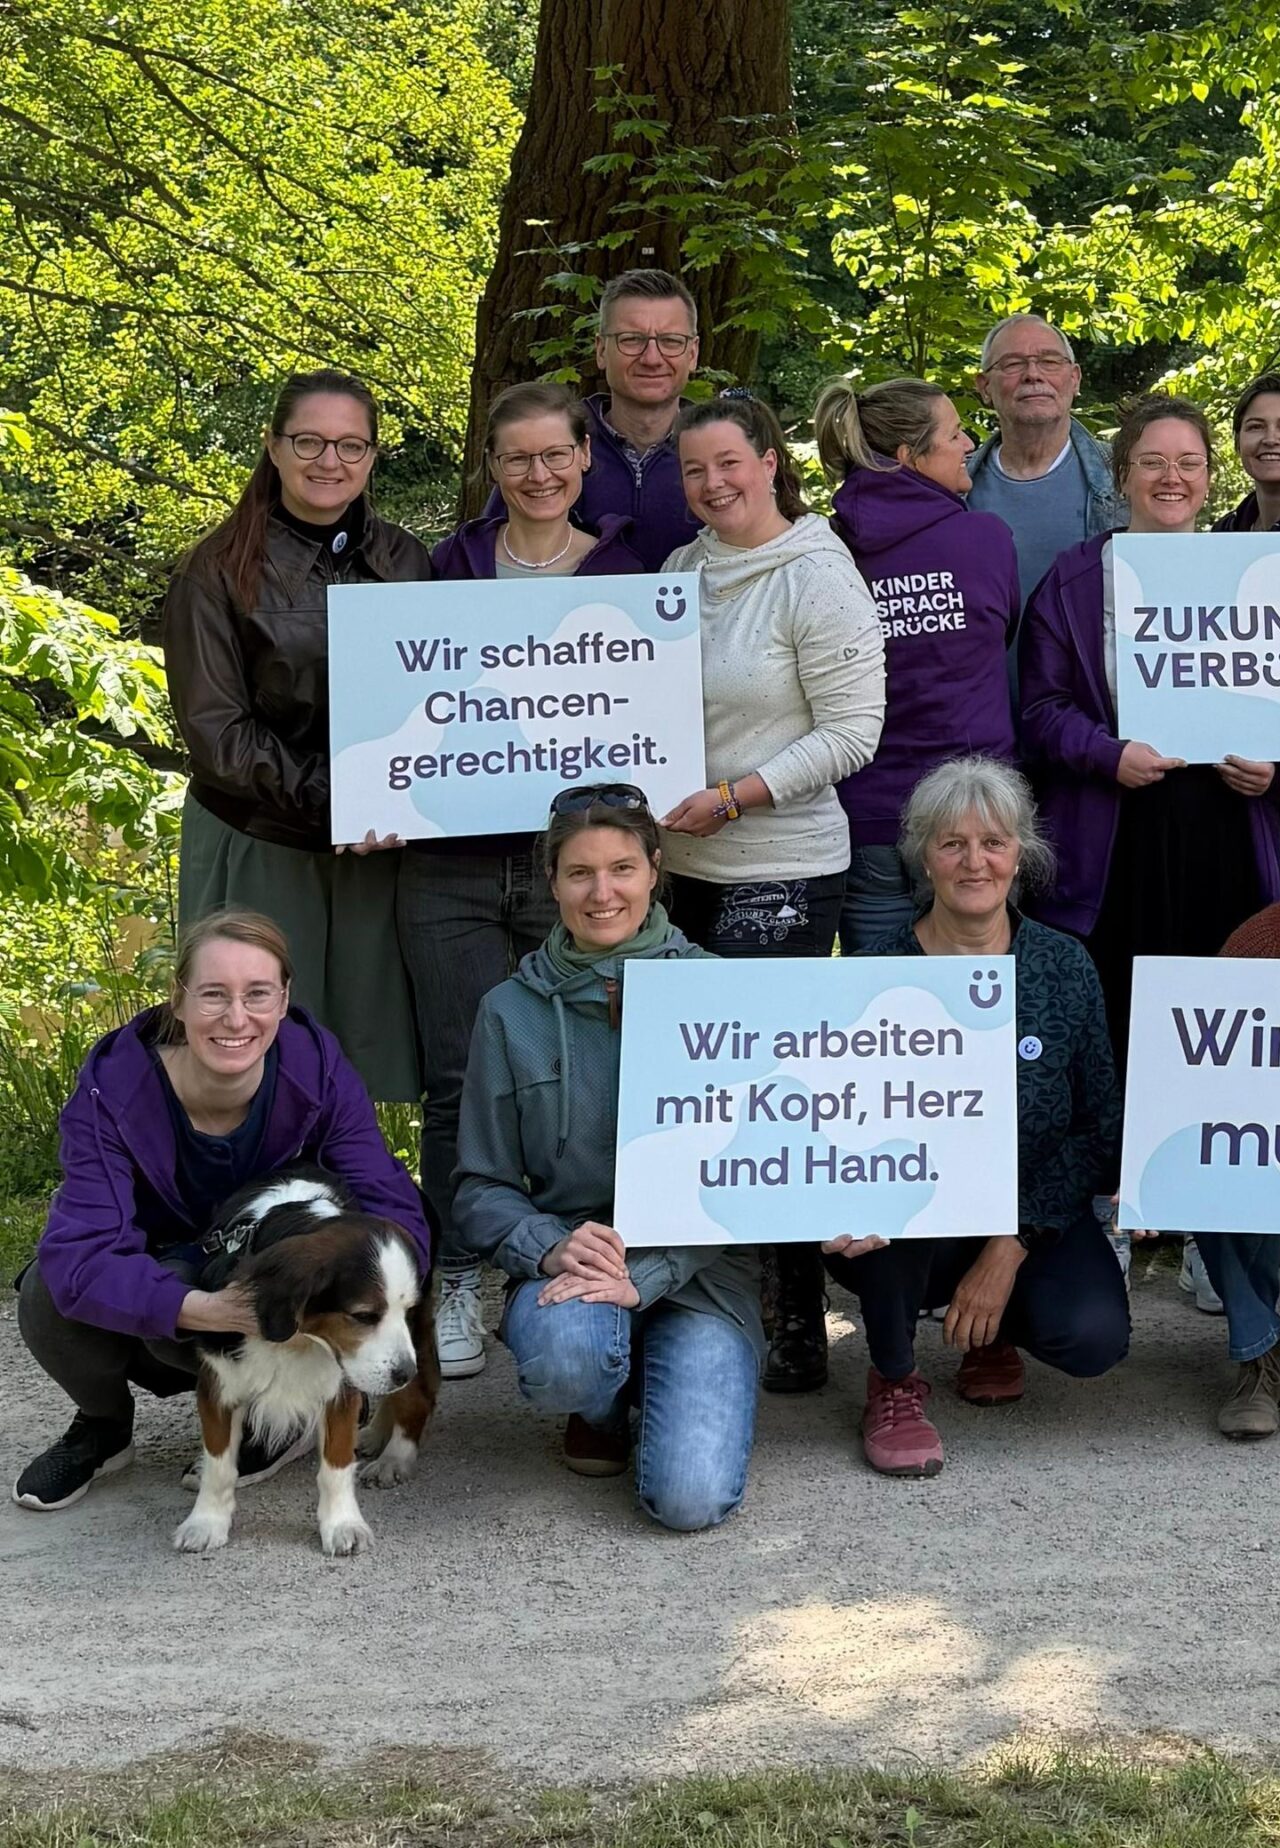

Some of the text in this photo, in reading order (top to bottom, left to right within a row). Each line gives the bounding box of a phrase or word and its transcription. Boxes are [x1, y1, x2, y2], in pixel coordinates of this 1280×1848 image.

[871, 571, 955, 598] KINDER
[876, 592, 964, 618] SPRACH
[396, 632, 654, 672] Wir schaffen
[425, 691, 629, 724] Chancen-
[388, 733, 667, 790] gerechtigkeit.
[679, 1019, 962, 1060] Wir arbeiten
[656, 1081, 983, 1132] mit Kopf, Herz
[700, 1143, 939, 1187] und Hand.
